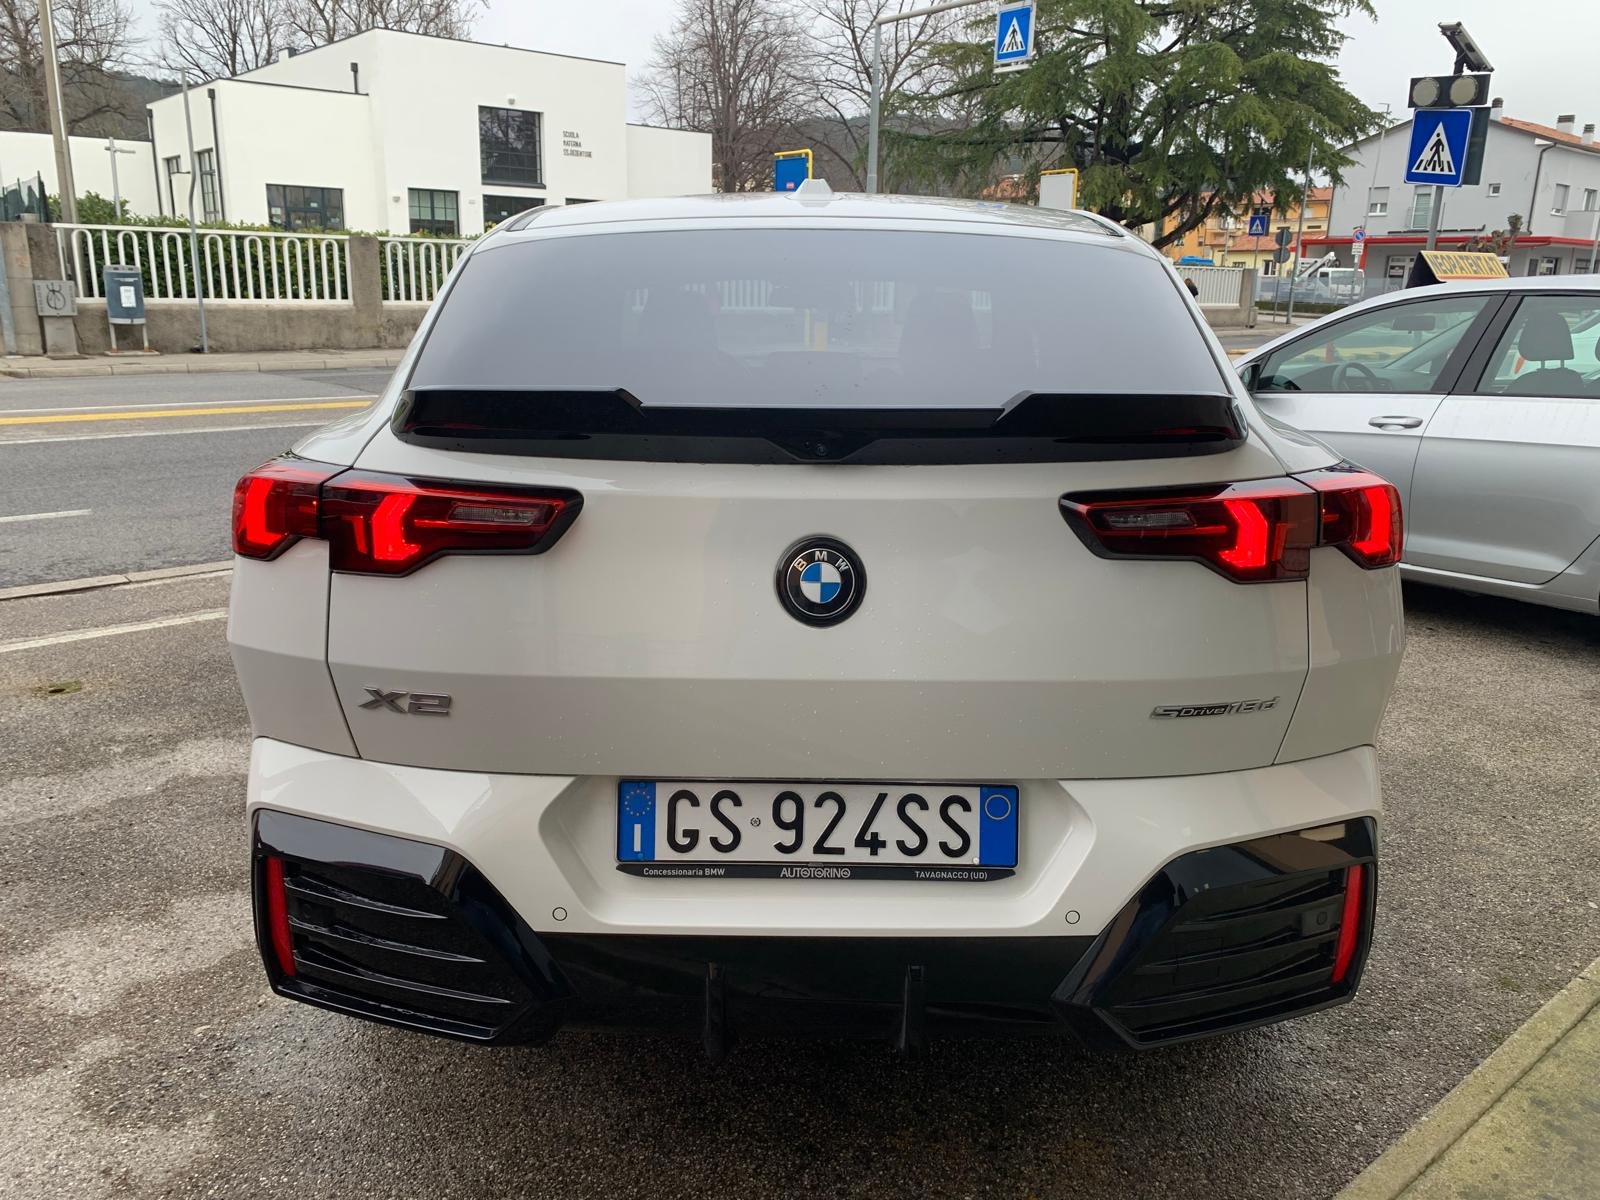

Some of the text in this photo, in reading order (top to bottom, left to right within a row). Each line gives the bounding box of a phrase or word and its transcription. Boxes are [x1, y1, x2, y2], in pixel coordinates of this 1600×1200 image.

[794, 550, 849, 573] BMW
[359, 687, 452, 716] X2
[666, 789, 972, 858] GS 924SS
[643, 868, 725, 876] Concessionaria BMW
[780, 867, 850, 878] AUTOTORINO
[914, 870, 988, 880] TAVAGNACCO (UD)
